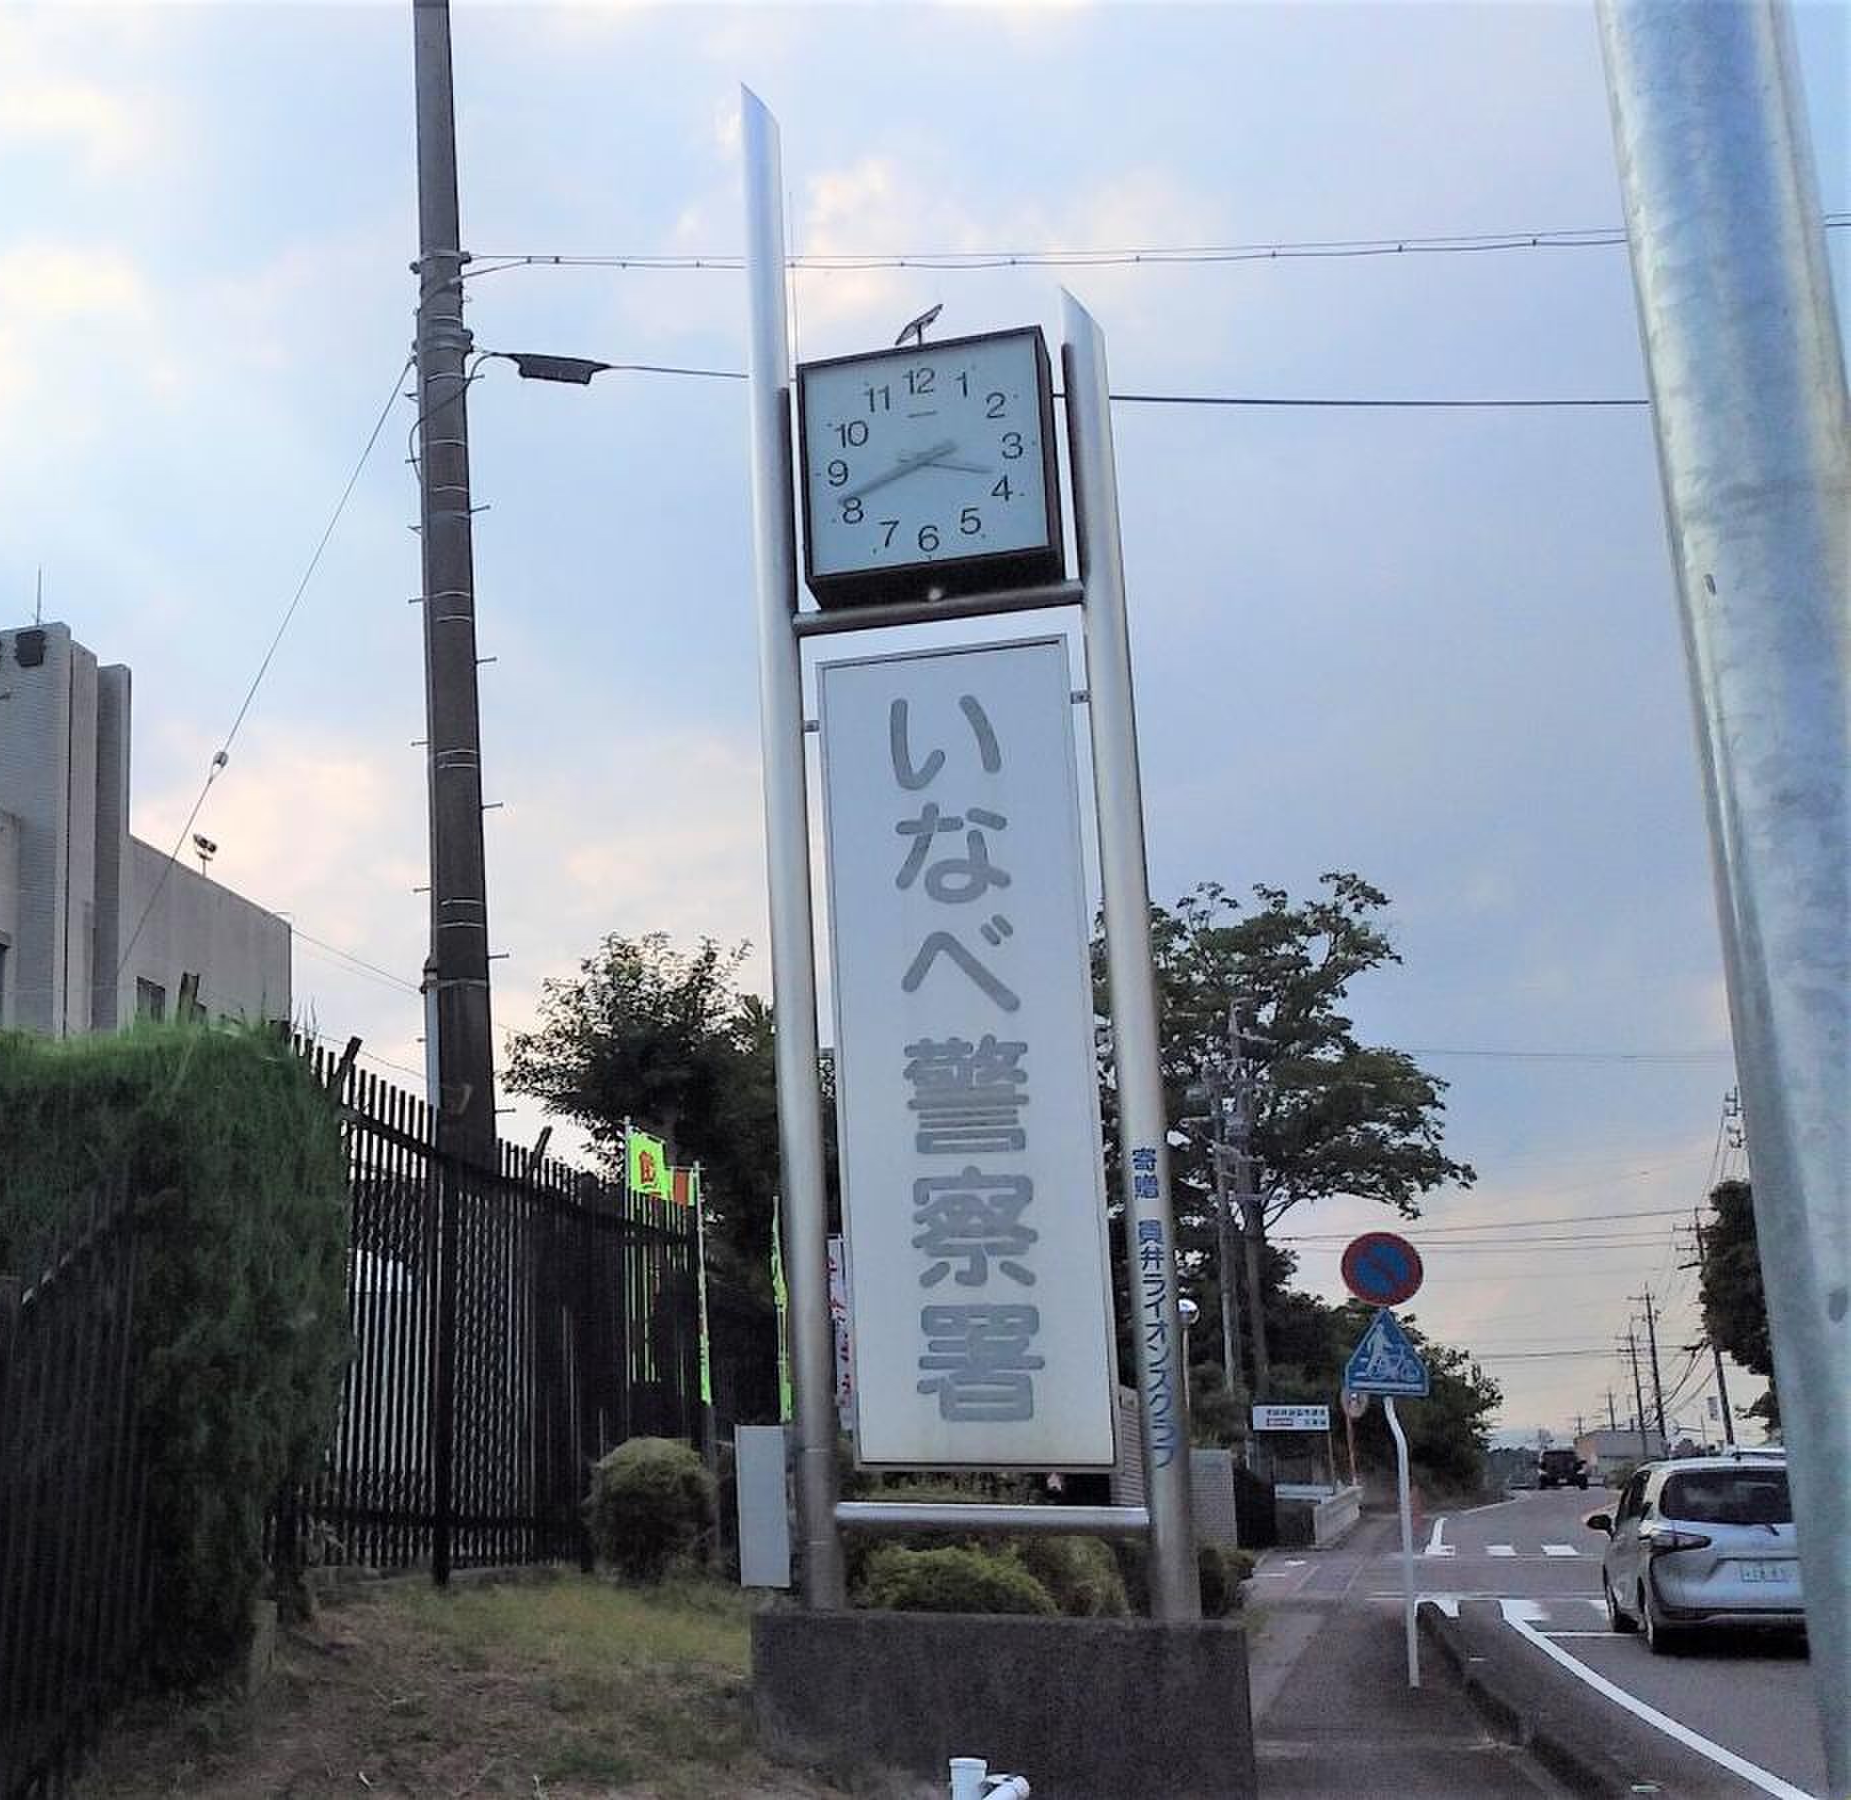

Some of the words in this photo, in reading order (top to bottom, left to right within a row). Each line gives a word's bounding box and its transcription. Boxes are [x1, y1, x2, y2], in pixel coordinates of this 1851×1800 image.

[902, 367, 935, 395] 12
[956, 371, 968, 397] 1
[865, 385, 891, 412] 11
[986, 392, 1007, 419] 2
[835, 421, 869, 448] 10
[1002, 432, 1023, 460] 3
[828, 460, 849, 487] 9
[991, 475, 1014, 501] 4
[842, 496, 864, 524] 8
[960, 508, 982, 535] 5
[880, 520, 900, 548] 7
[918, 525, 939, 552] 6
[890, 694, 1046, 1422] いなべ警察署
